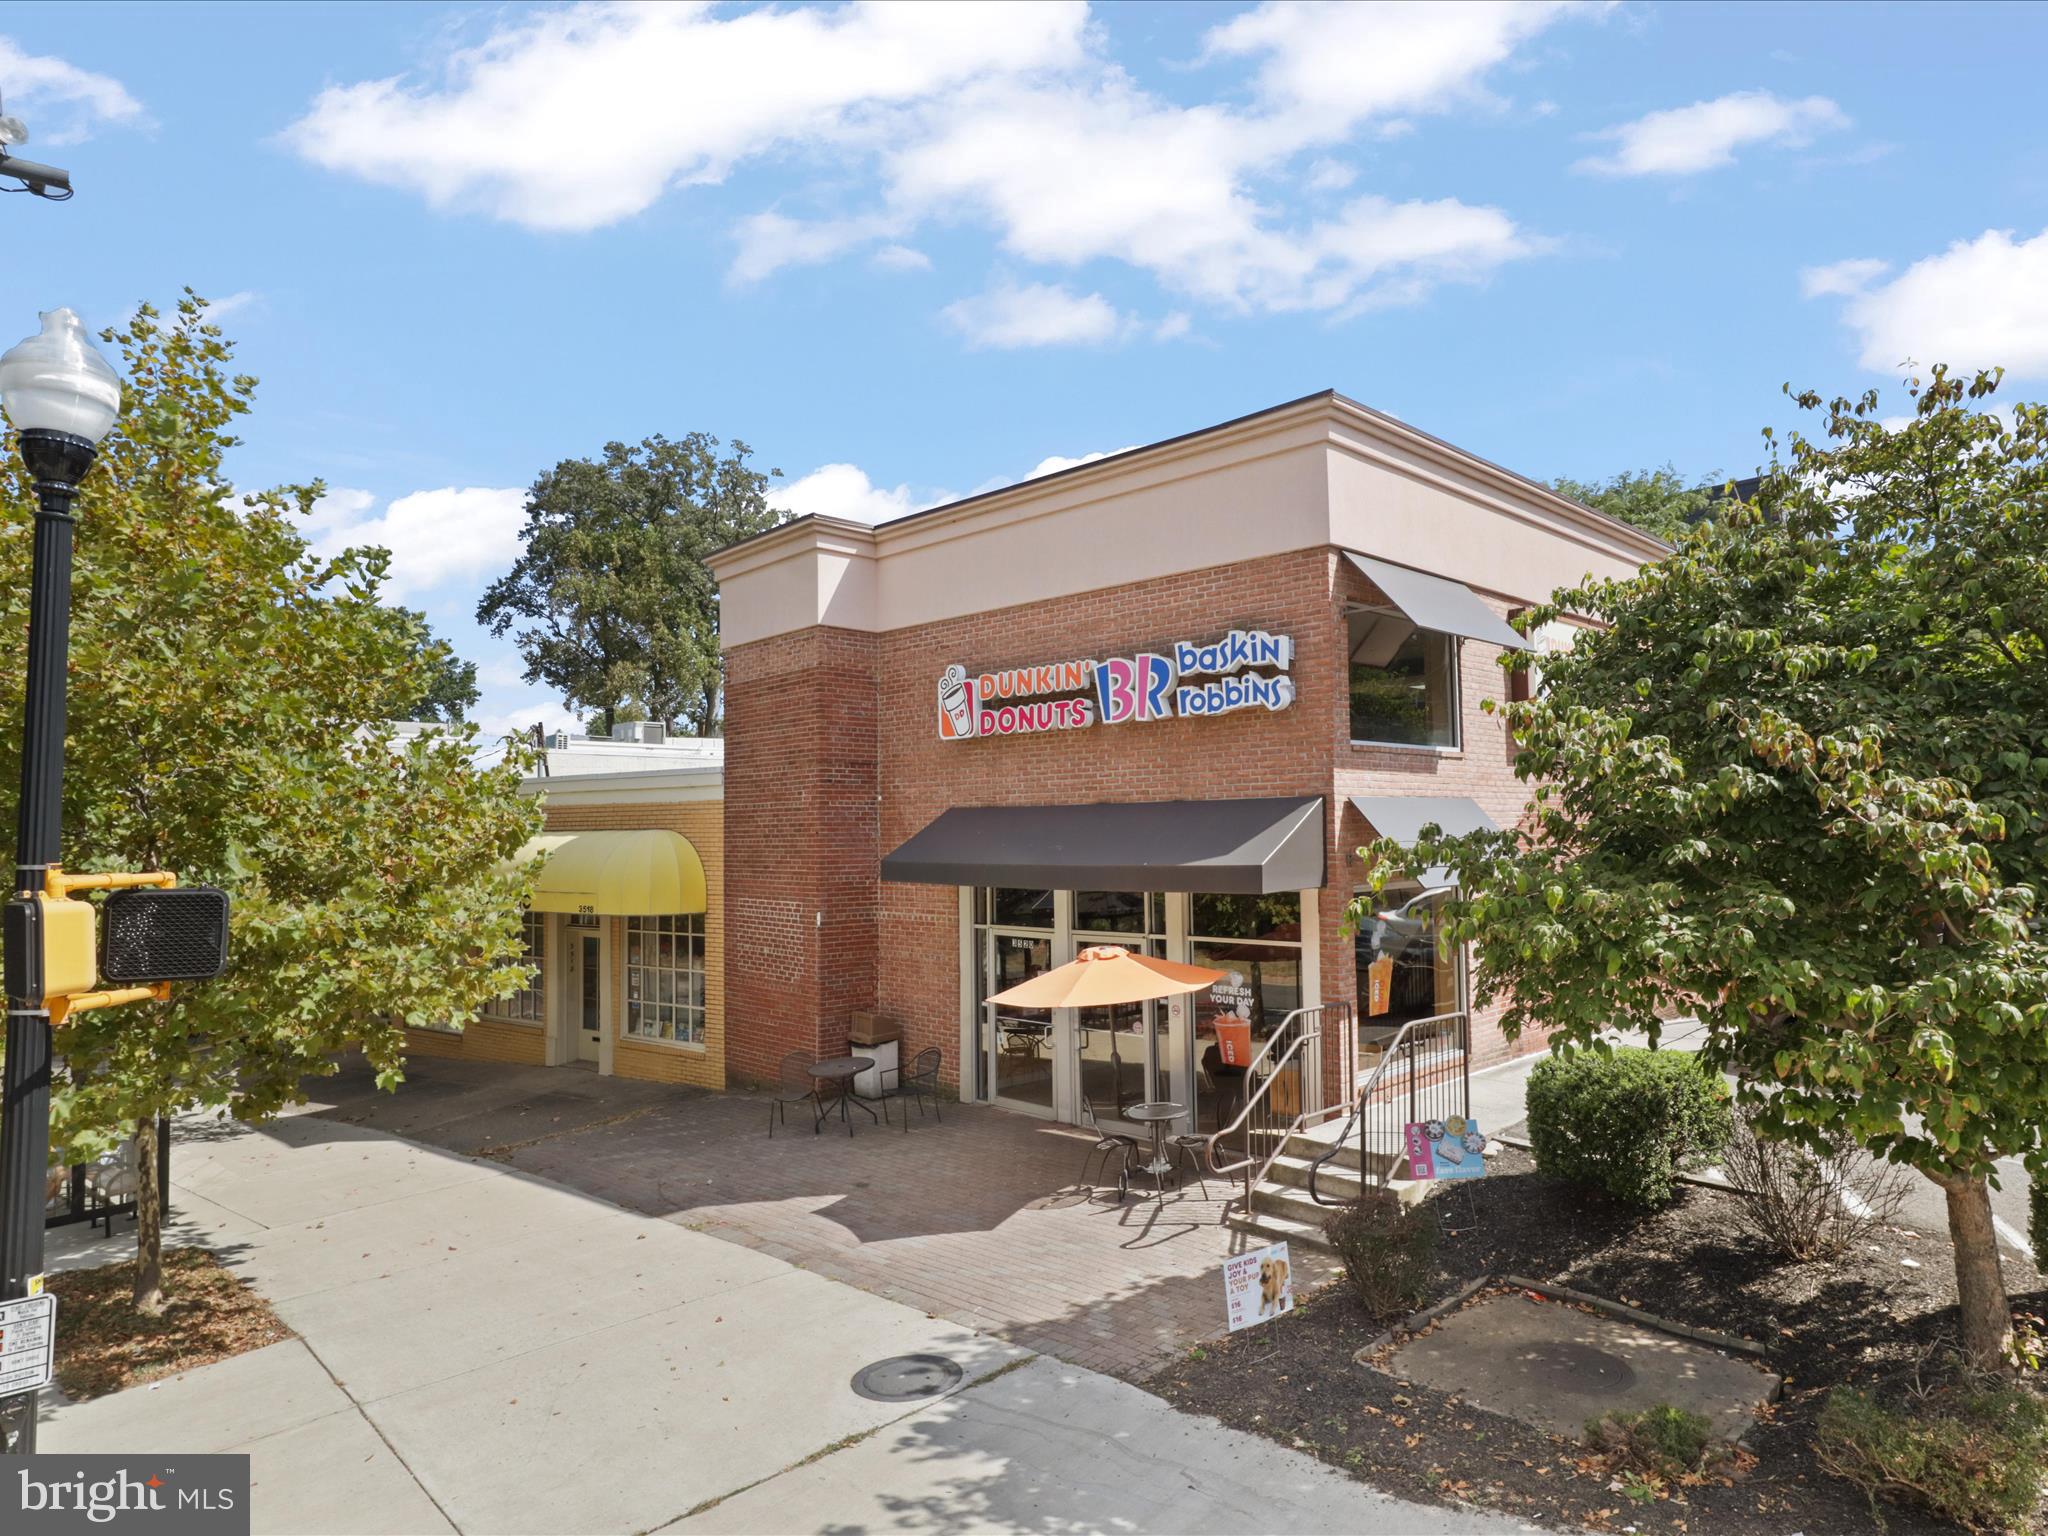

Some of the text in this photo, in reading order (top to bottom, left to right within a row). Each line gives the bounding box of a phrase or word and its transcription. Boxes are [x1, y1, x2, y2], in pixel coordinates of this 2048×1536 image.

[979, 661, 1090, 699] DUNKIN'
[1096, 655, 1173, 722] BR
[980, 699, 1087, 736] DONUTS
[578, 904, 594, 913] 3518
[1212, 985, 1252, 997] REFRESH
[1209, 994, 1255, 1007] YOUR DAY
[1226, 1040, 1236, 1063] ICED
[1228, 1257, 1257, 1271] GIVE KIDS
[1229, 1271, 1241, 1279] JOY
[1229, 1272, 1260, 1286] YOUR PUP
[1236, 1284, 1248, 1293] TOY
